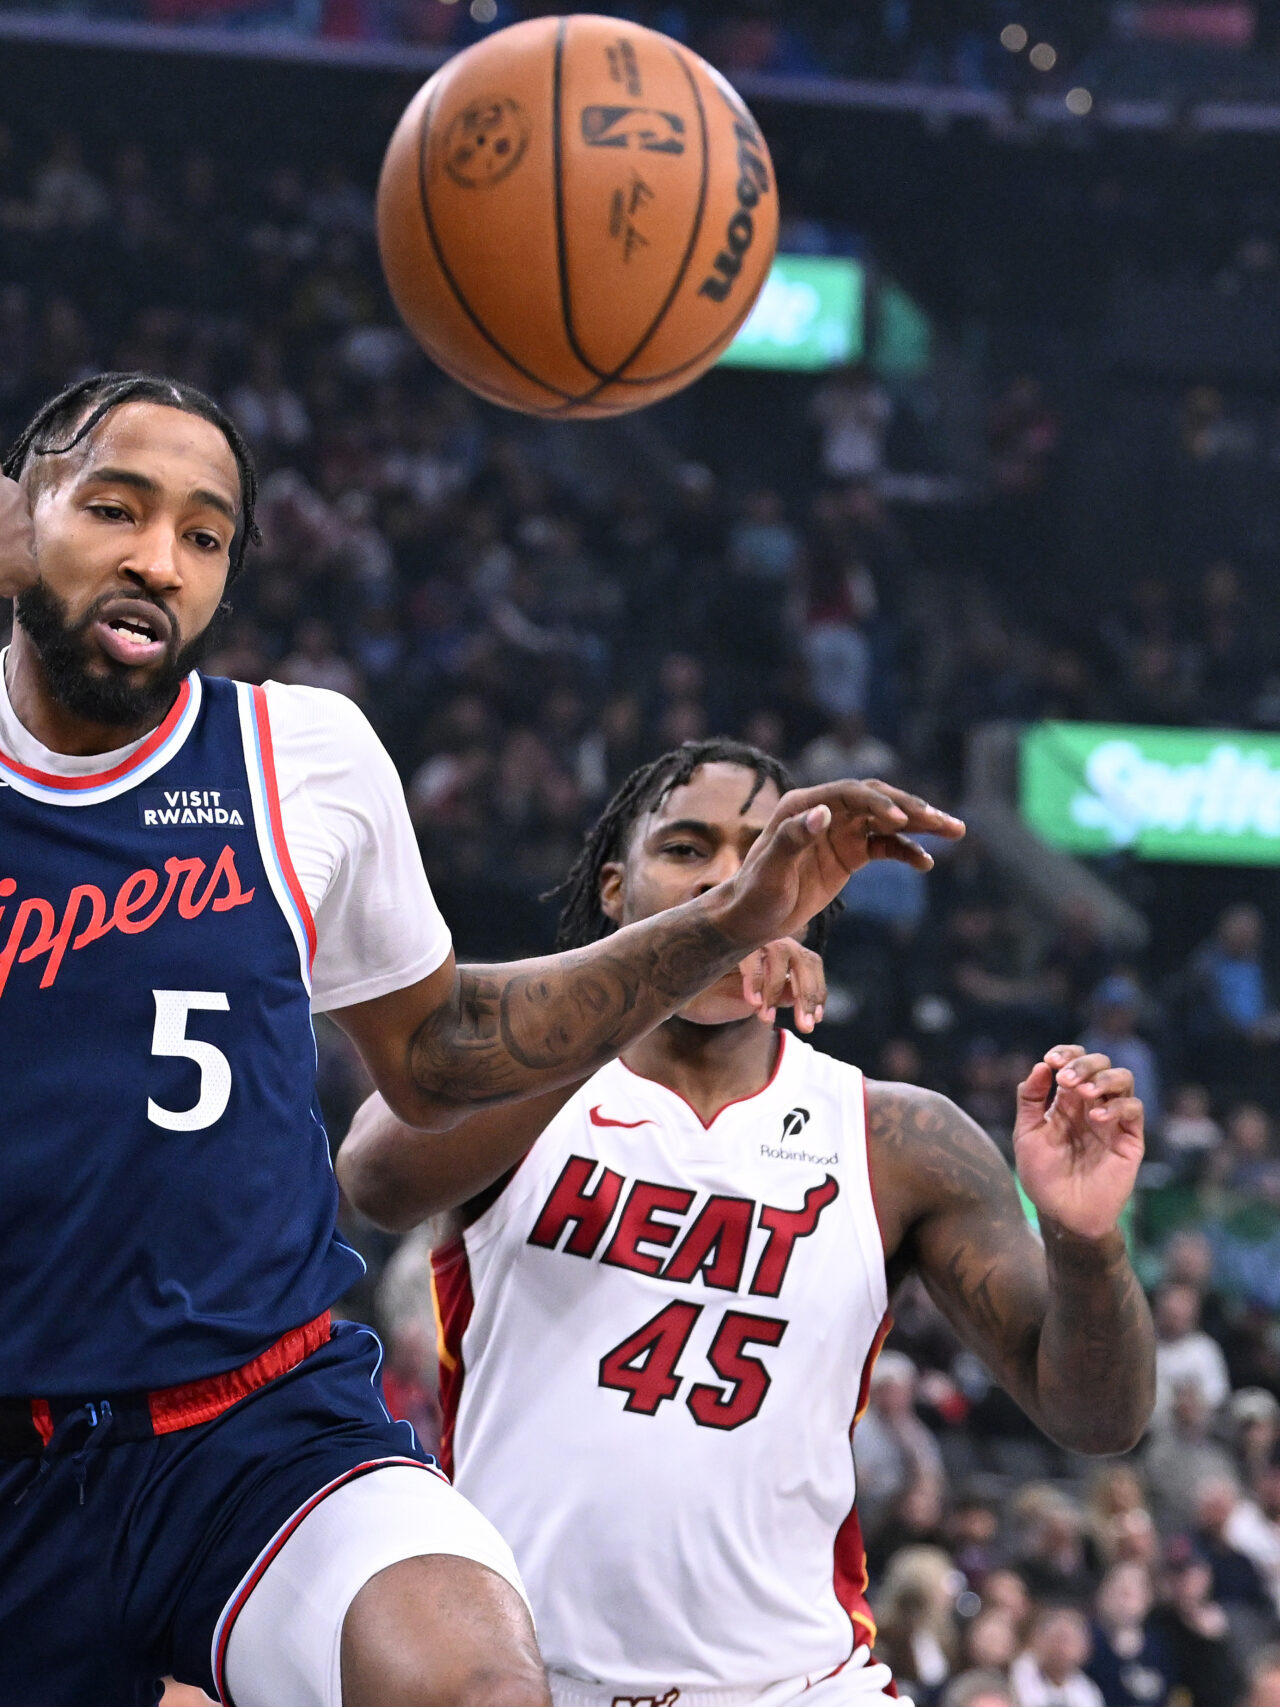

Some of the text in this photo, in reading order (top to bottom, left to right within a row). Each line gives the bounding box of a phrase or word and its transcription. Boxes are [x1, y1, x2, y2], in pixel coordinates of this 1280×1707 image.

[698, 120, 769, 303] ilson
[144, 808, 244, 826] RWANDA
[164, 791, 221, 807] VISIT
[147, 989, 232, 1132] 5
[760, 1144, 839, 1165] Robinhood
[526, 1154, 840, 1299] HEAT
[598, 1299, 789, 1431] 45
